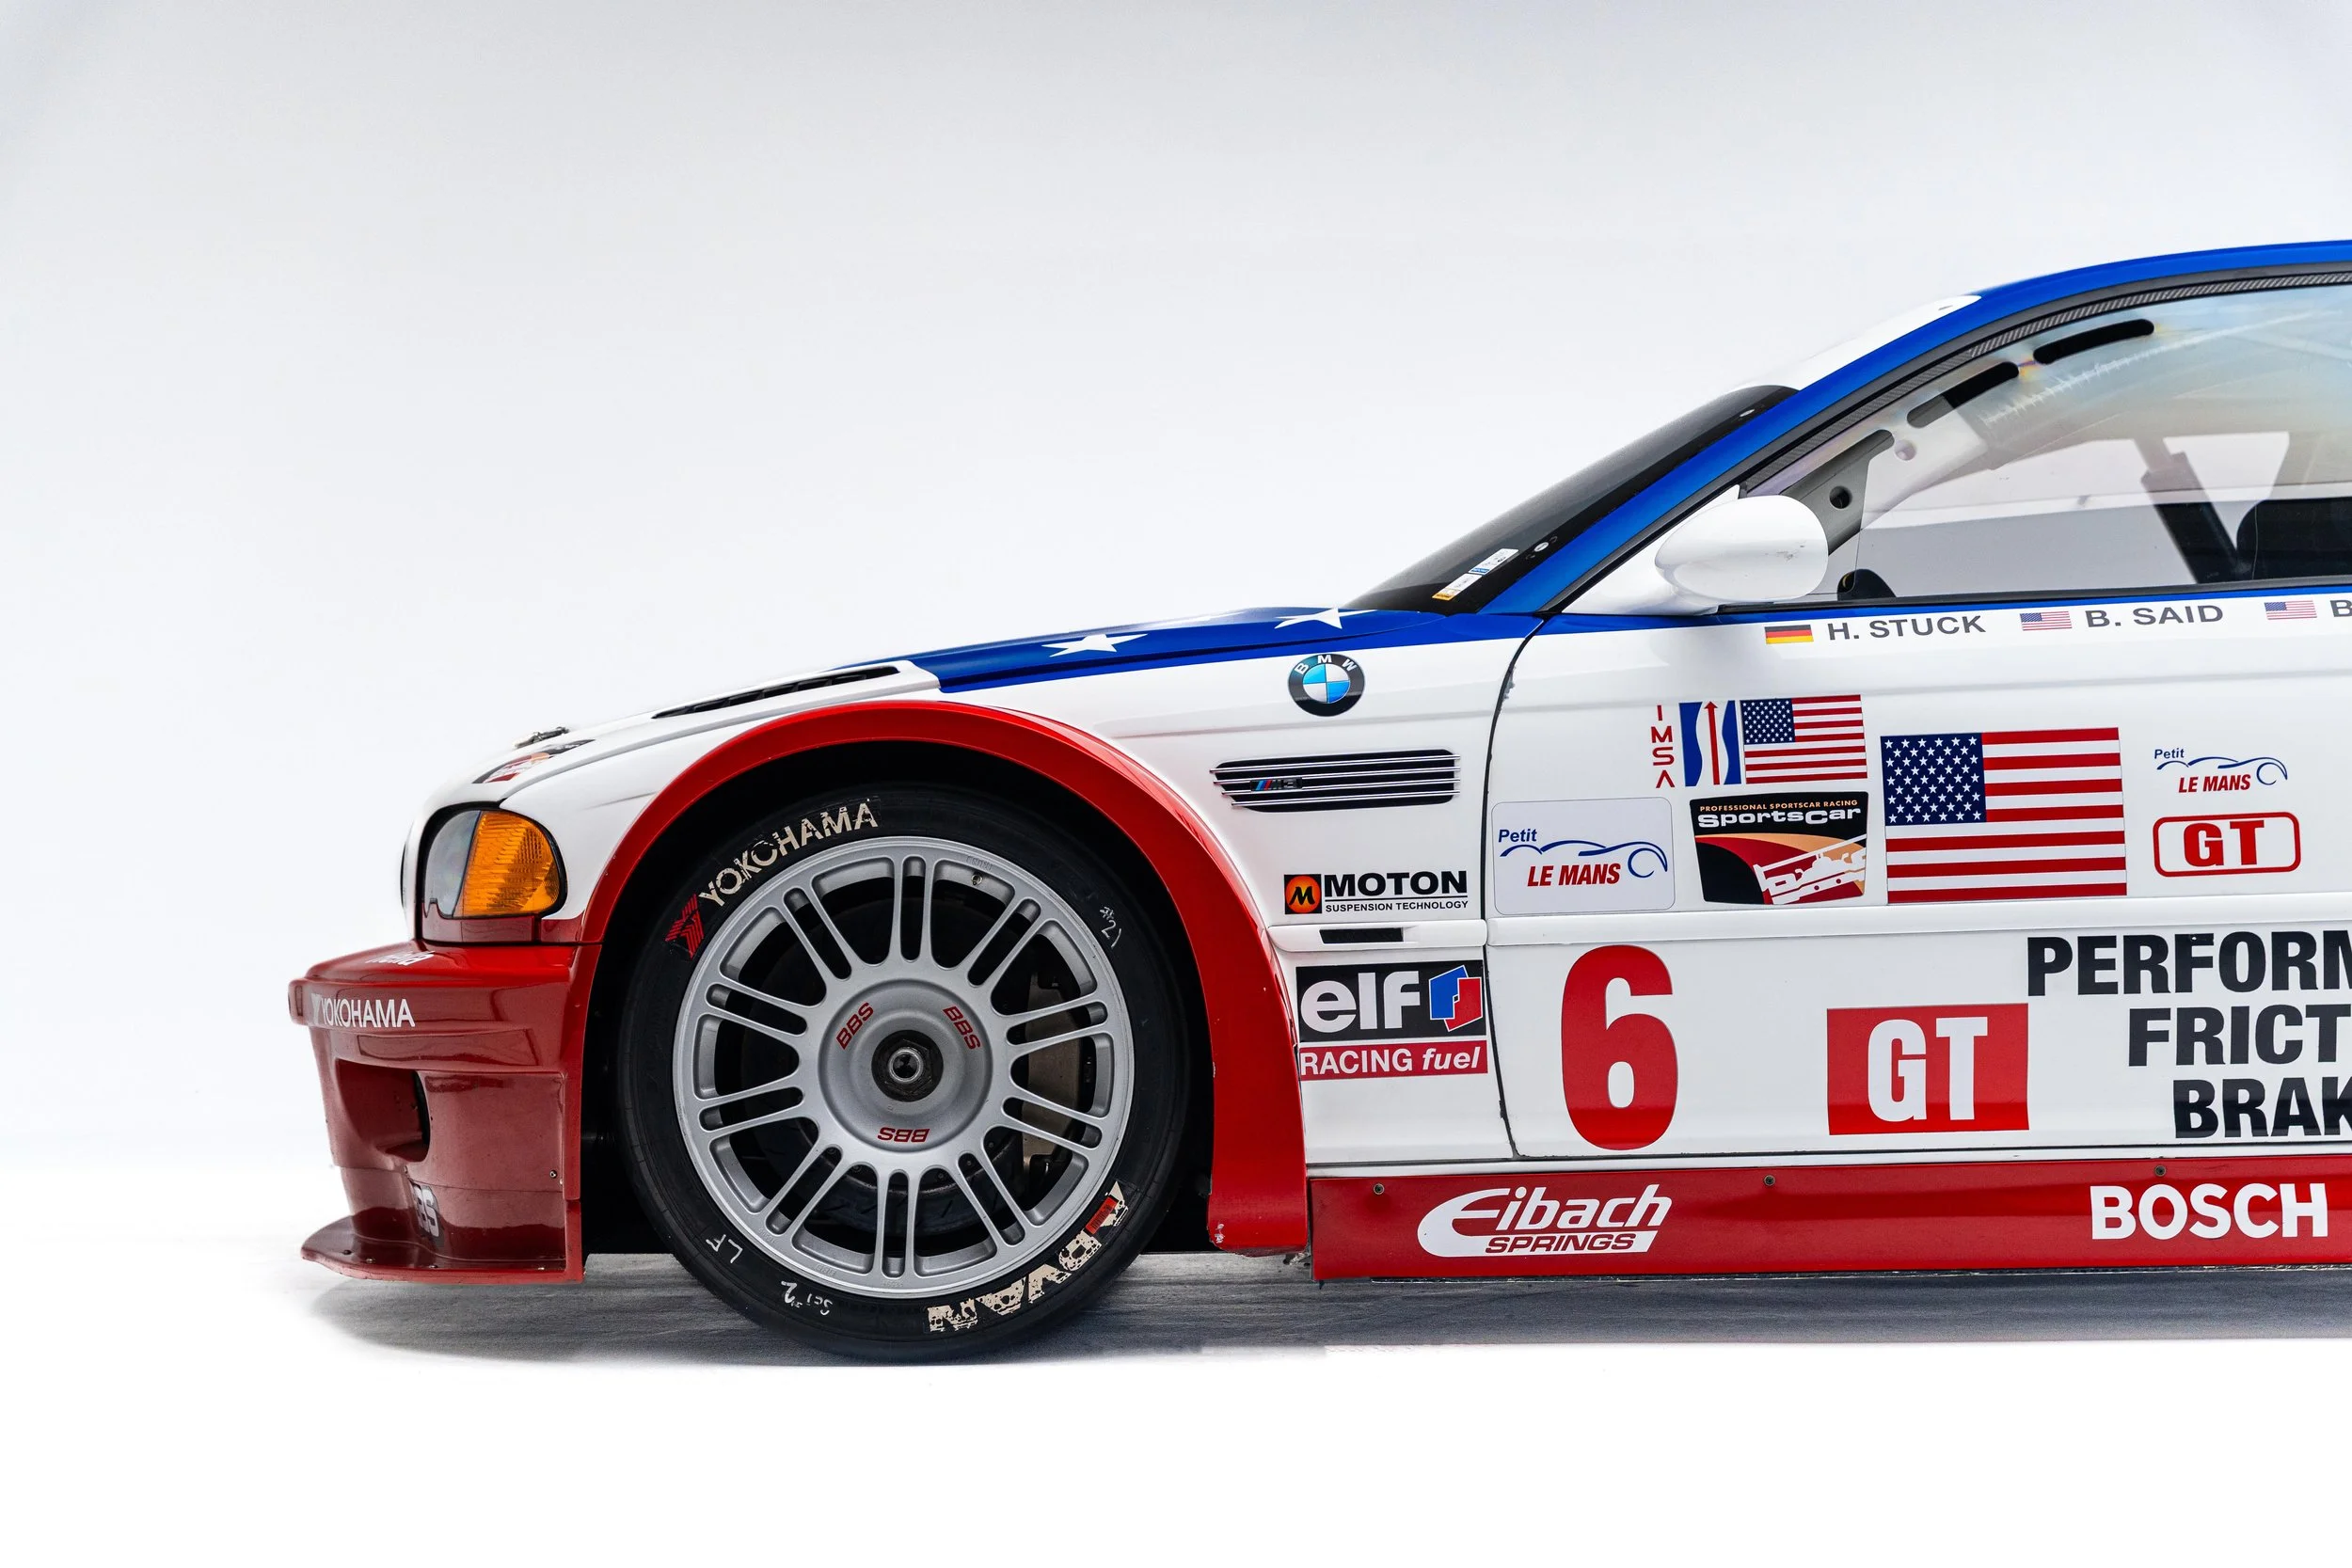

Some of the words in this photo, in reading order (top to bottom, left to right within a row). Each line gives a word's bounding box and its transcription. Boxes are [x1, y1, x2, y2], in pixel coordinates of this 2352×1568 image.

[1827, 623, 1860, 641] H.
[1869, 615, 1987, 638] STUCK
[2086, 610, 2122, 628] B.
[2133, 605, 2224, 626] SAID
[1294, 655, 1358, 674] BMW
[1651, 705, 1676, 788] IMSA
[2153, 748, 2185, 759] Petit
[2178, 777, 2199, 793] LE
[2202, 774, 2251, 792] MANS
[1700, 803, 1768, 812] PROFESSIONAL
[1498, 828, 1537, 843] Petit
[2183, 819, 2265, 867] GT
[698, 802, 879, 908] YOKOHAMA
[1324, 871, 1468, 897] MOTON
[1527, 865, 1554, 887] LE
[1558, 863, 1621, 886] MANS
[1326, 902, 1393, 912] SUSPENSION
[1396, 900, 1469, 911] TECHNOLOGY
[321, 998, 416, 1028] YOKOHAMA
[1300, 971, 1421, 1034] elf
[836, 1002, 874, 1050] BBS
[942, 1006, 981, 1050] BBS
[2128, 1004, 2352, 1067] FRICT
[1300, 1048, 1412, 1076] RACING
[1422, 1046, 1481, 1070] fuel
[1561, 944, 1678, 1150] 6
[1867, 1016, 1988, 1122] GT
[2173, 1076, 2352, 1139] BRAK
[877, 1127, 930, 1143] BBS
[411, 1185, 439, 1238] BS
[1417, 1183, 1673, 1257] Eibach
[2090, 1182, 2329, 1241] BOSCH
[706, 1234, 743, 1263] LF
[1485, 1232, 1637, 1254] SPRINGS
